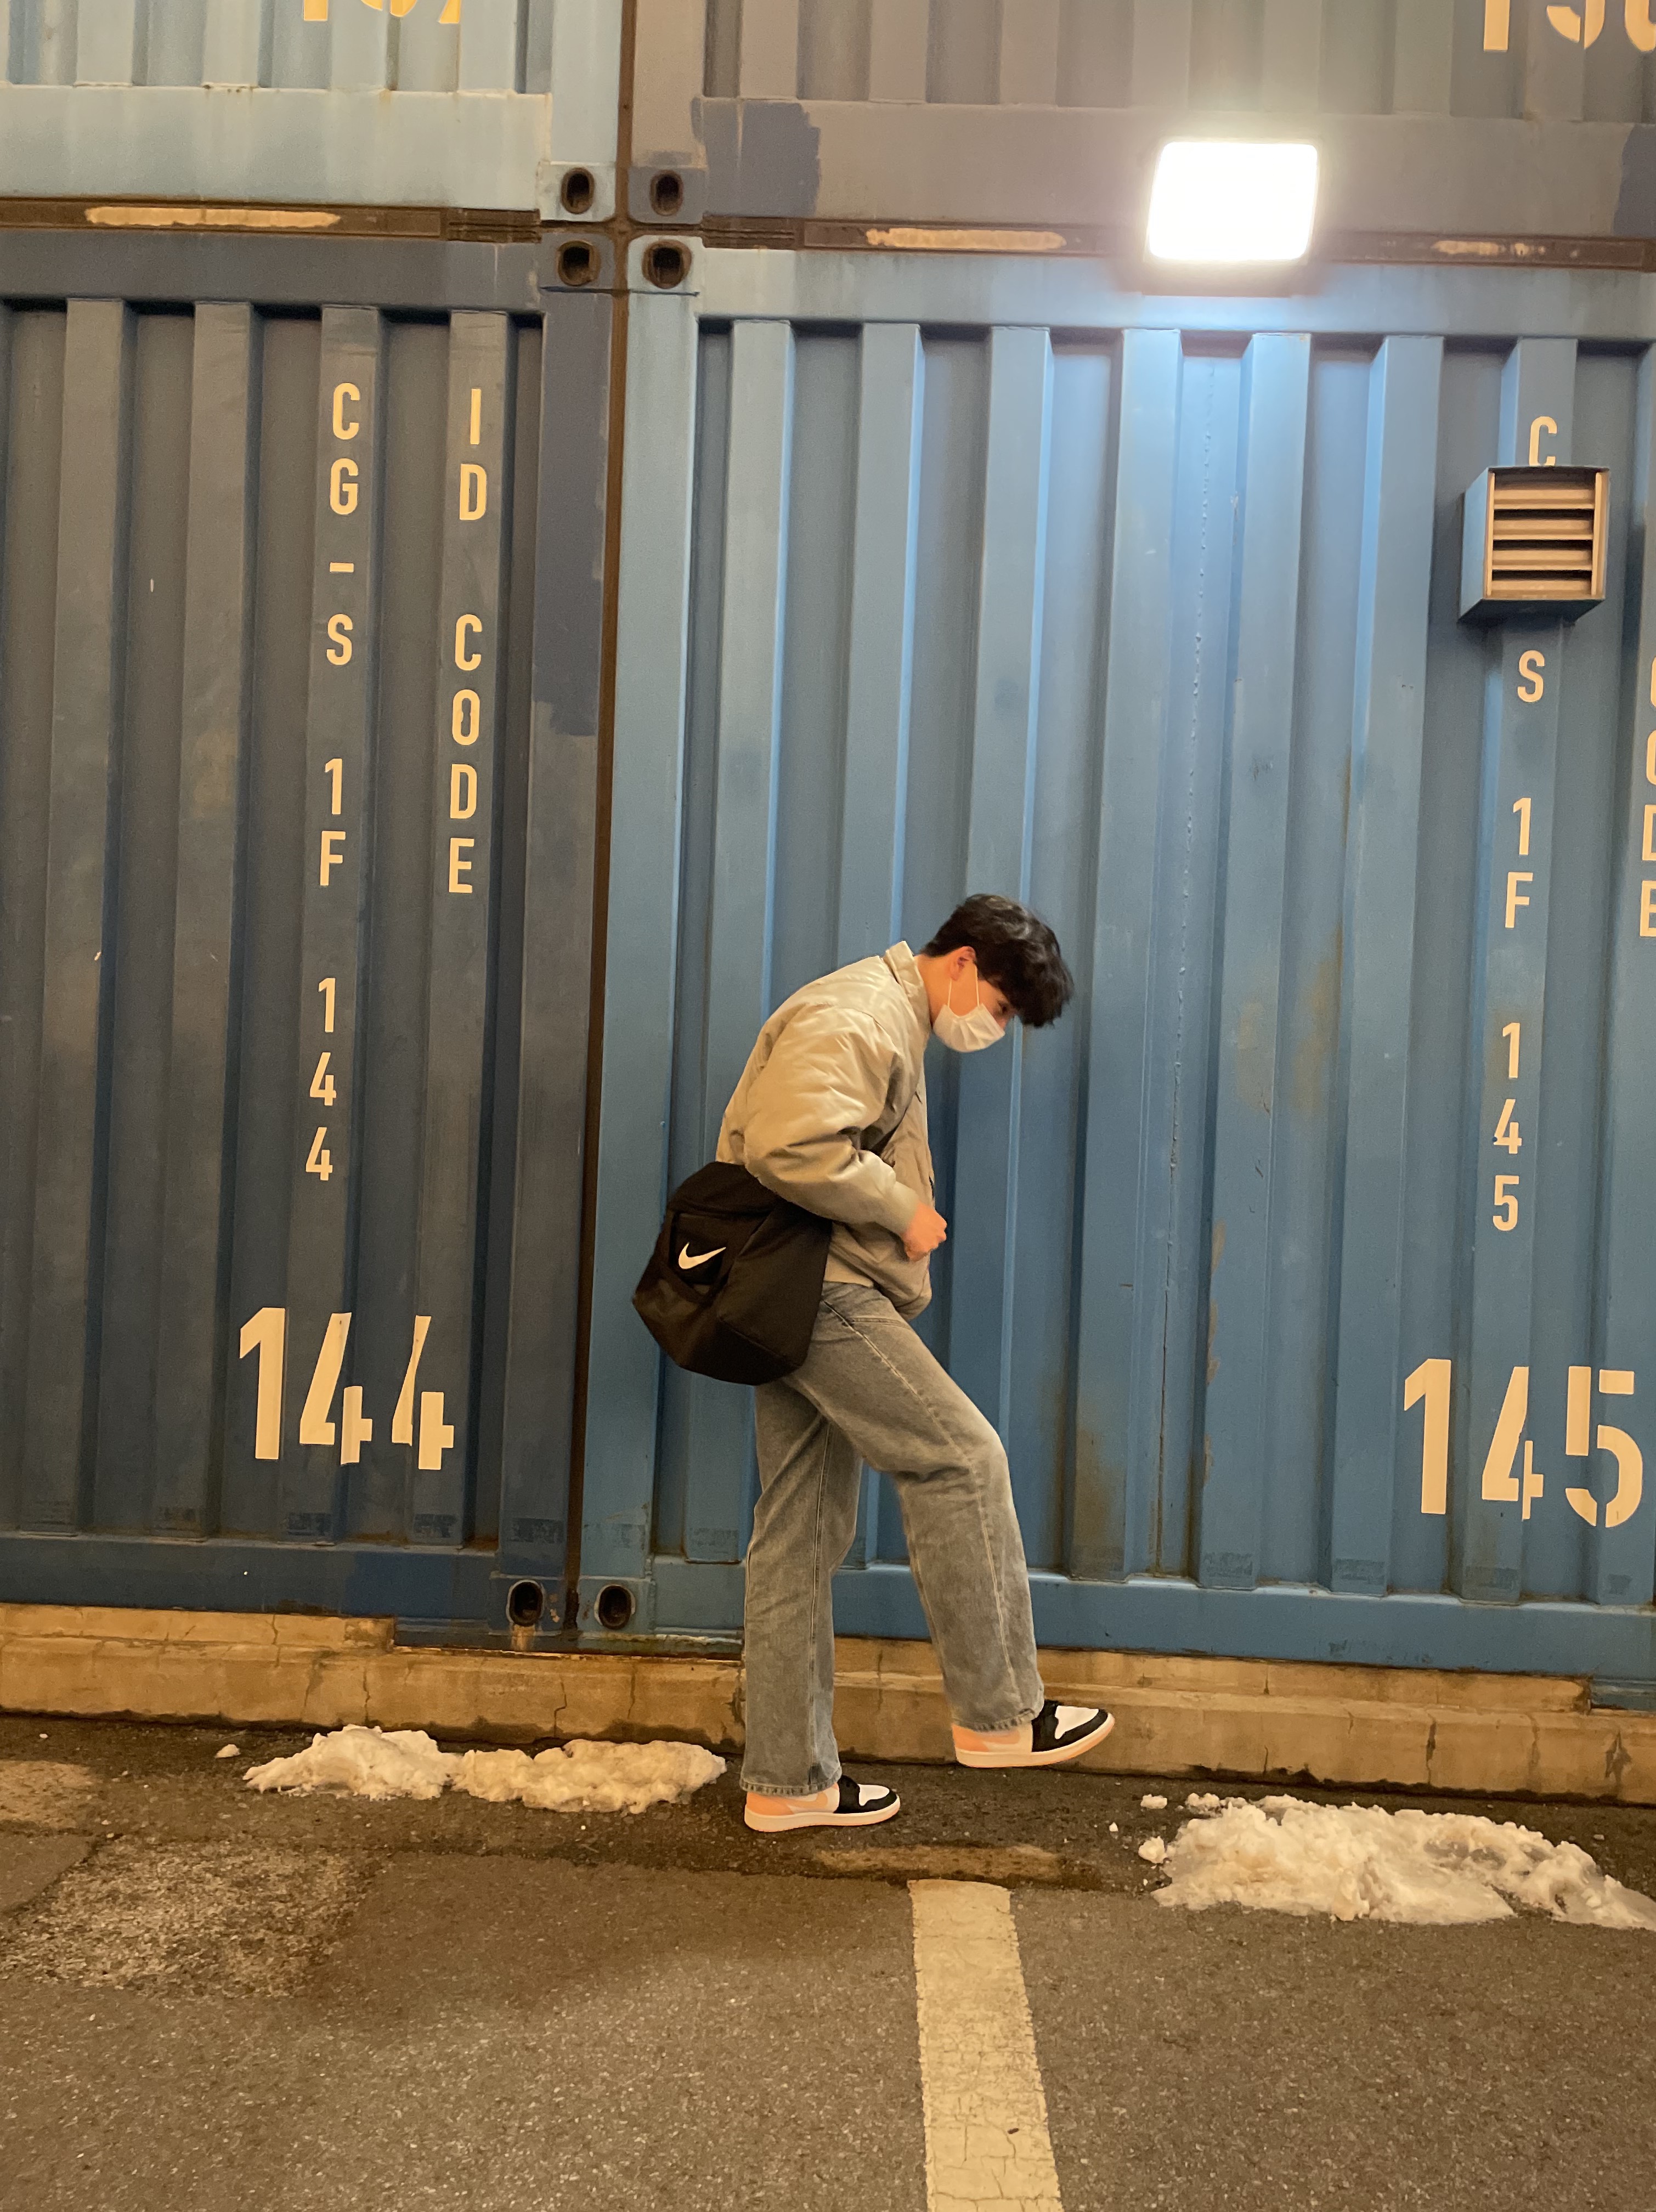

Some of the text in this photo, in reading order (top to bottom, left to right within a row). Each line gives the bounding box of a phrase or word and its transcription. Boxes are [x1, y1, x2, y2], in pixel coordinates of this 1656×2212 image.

[448, 388, 487, 893] ID CODE
[306, 382, 360, 1181] CG-S 1F 144
[1505, 798, 1534, 929] 1F
[1493, 1022, 1522, 1232] 145
[240, 1307, 454, 1471] 144
[1404, 1358, 1643, 1528] 145
